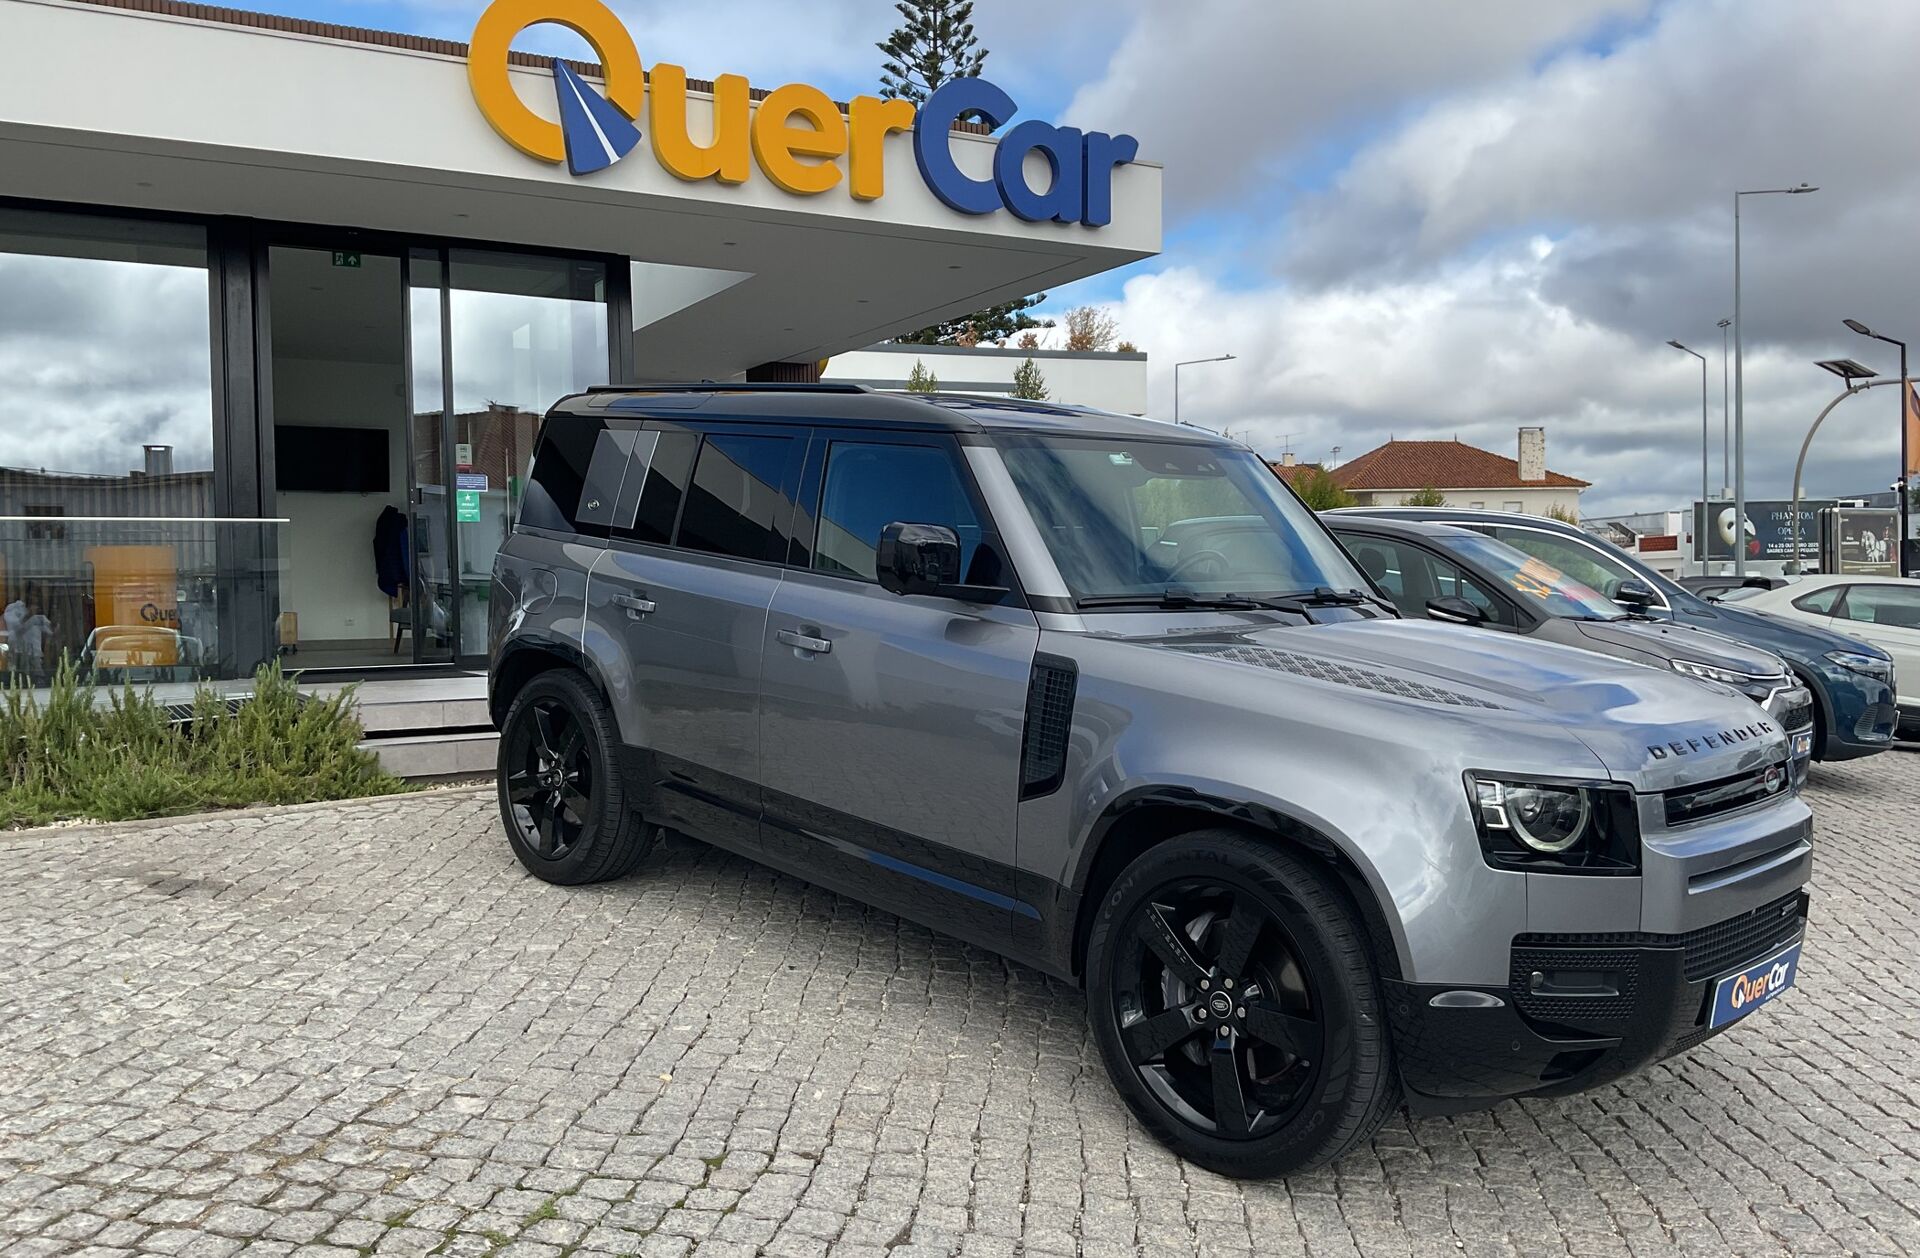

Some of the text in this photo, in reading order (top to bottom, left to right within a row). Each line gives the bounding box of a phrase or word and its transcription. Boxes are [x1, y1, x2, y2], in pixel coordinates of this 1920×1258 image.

[468, 0, 1138, 227] QuerCar
[1771, 511, 1814, 520] PHANTOM
[1777, 527, 1806, 535] OPEA
[1647, 722, 1774, 759] DEFENDER
[1731, 962, 1790, 1009] QuerCar
